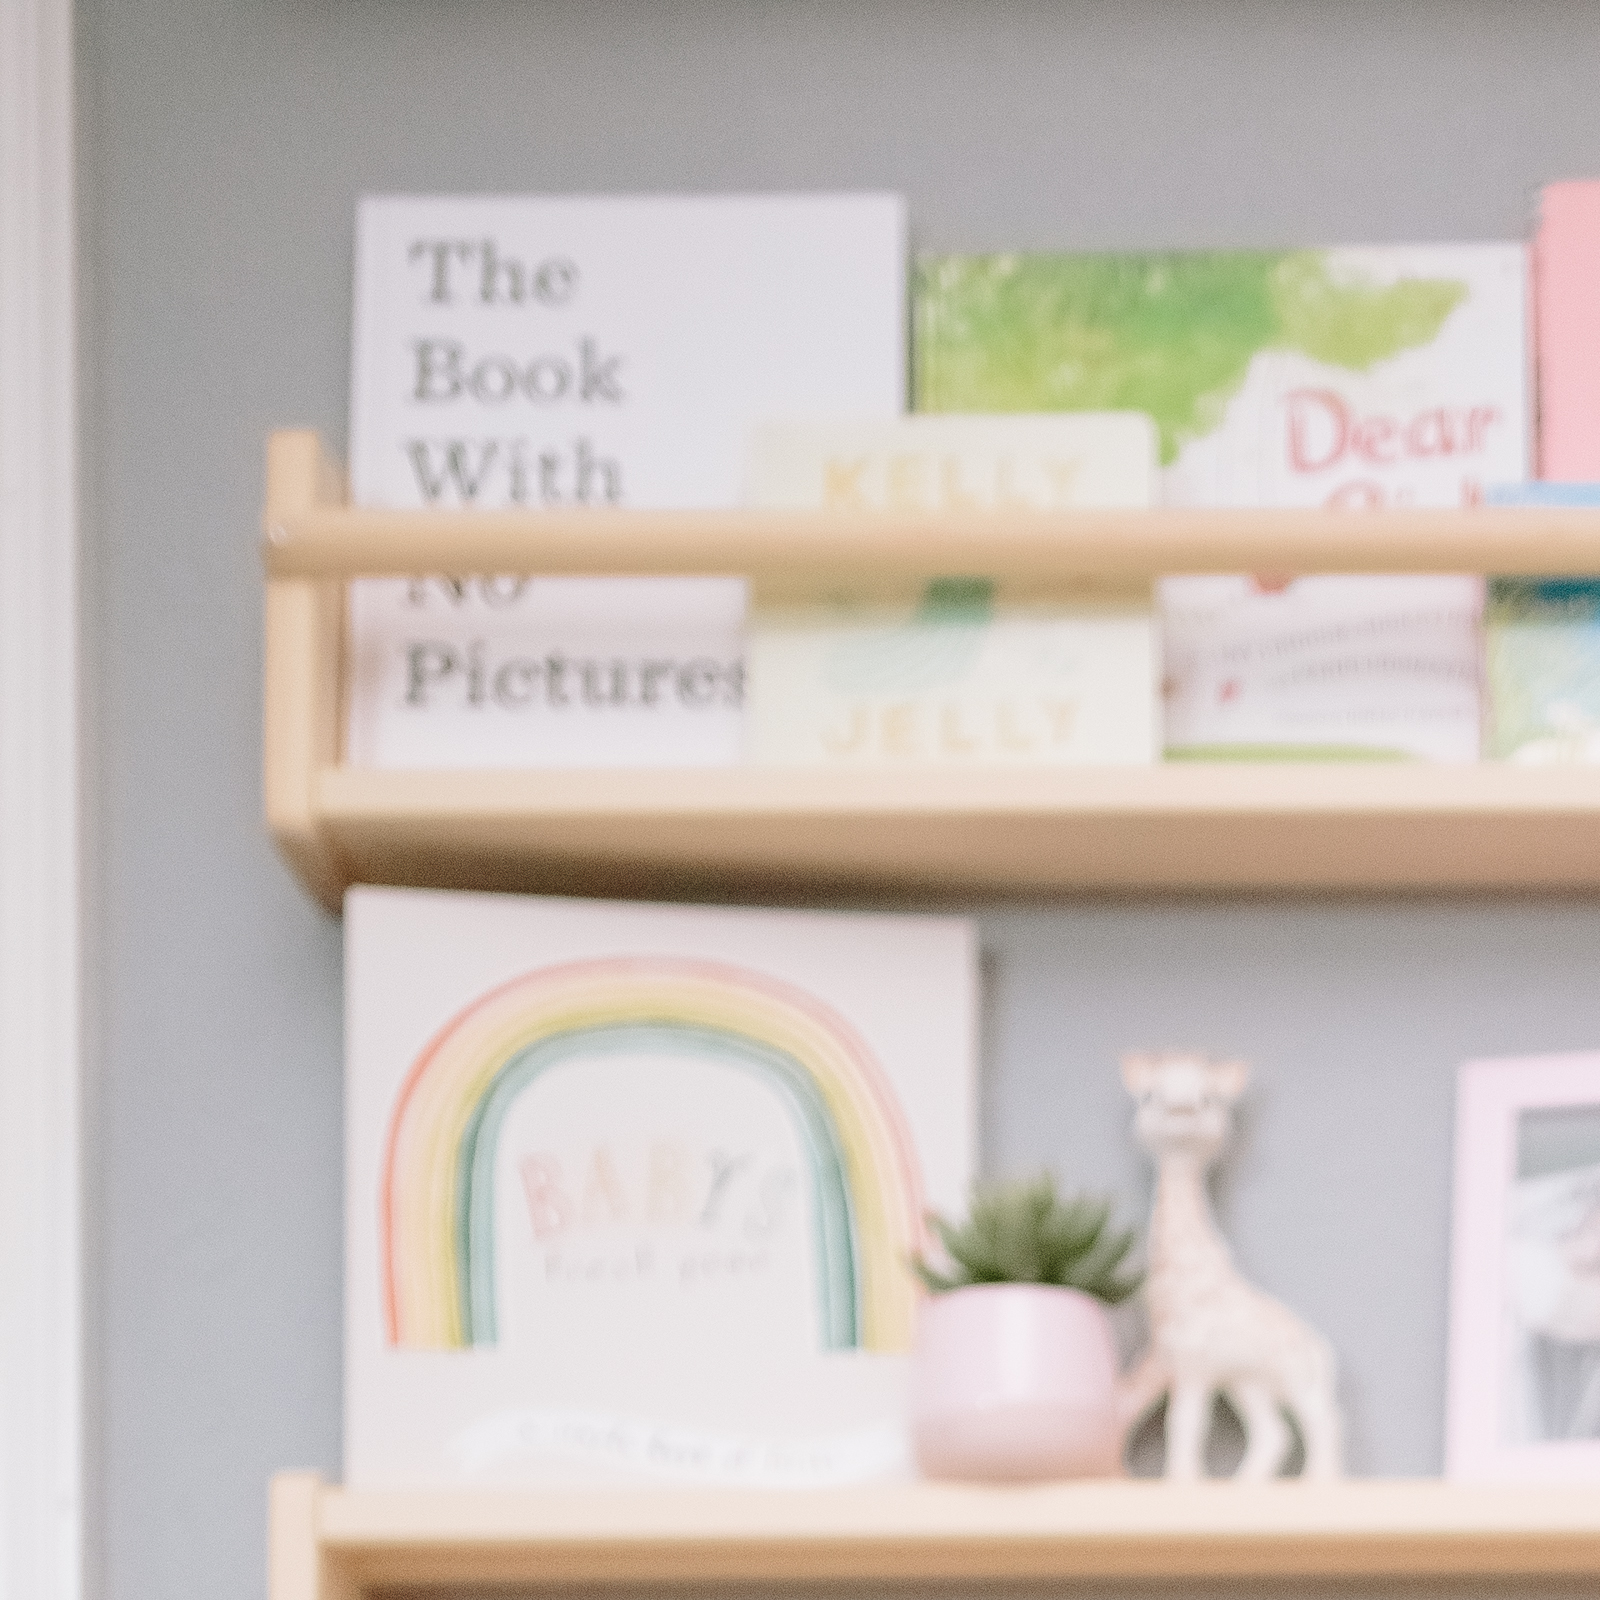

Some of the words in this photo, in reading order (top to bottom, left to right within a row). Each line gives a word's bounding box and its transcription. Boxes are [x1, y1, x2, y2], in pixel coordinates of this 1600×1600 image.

[407, 236, 580, 308] The
[408, 338, 626, 406] Book
[1284, 387, 1500, 474] Dear
[405, 437, 624, 507] With
